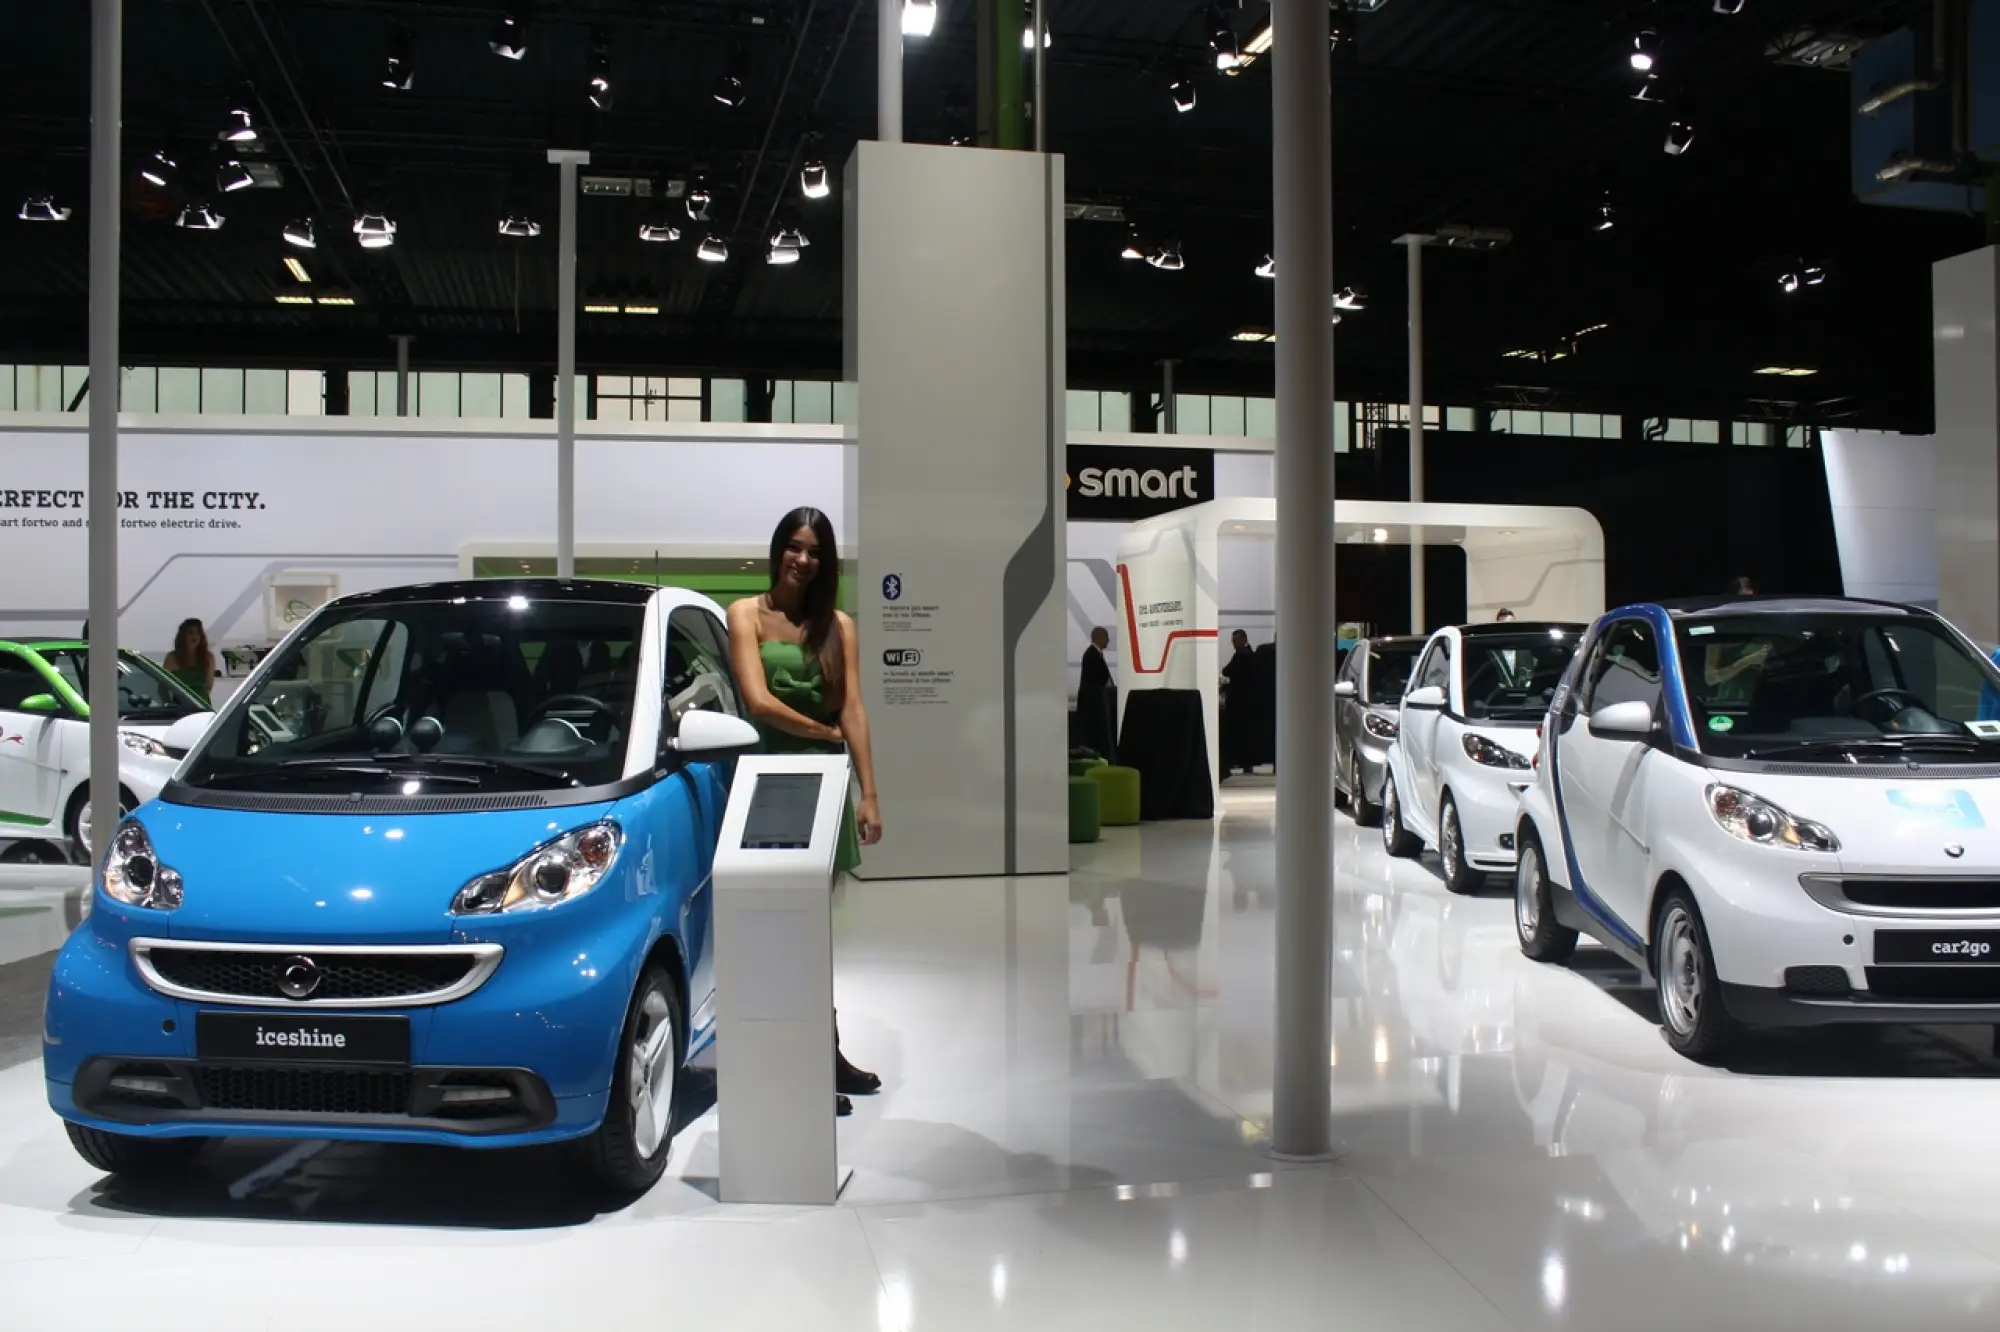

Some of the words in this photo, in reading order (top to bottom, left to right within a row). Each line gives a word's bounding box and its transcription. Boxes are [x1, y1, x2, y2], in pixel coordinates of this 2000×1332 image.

[1078, 465, 1198, 499] smart
[0, 490, 84, 508] RFECT
[147, 491, 195, 509] THE
[202, 491, 266, 509] CITY.
[22, 517, 58, 528] fortwo
[62, 517, 83, 528] and
[121, 518, 157, 529] fortwo
[160, 518, 205, 529] electric
[208, 518, 242, 529] drive.
[1931, 940, 1990, 956] car2go
[255, 1027, 346, 1047] iceshine
